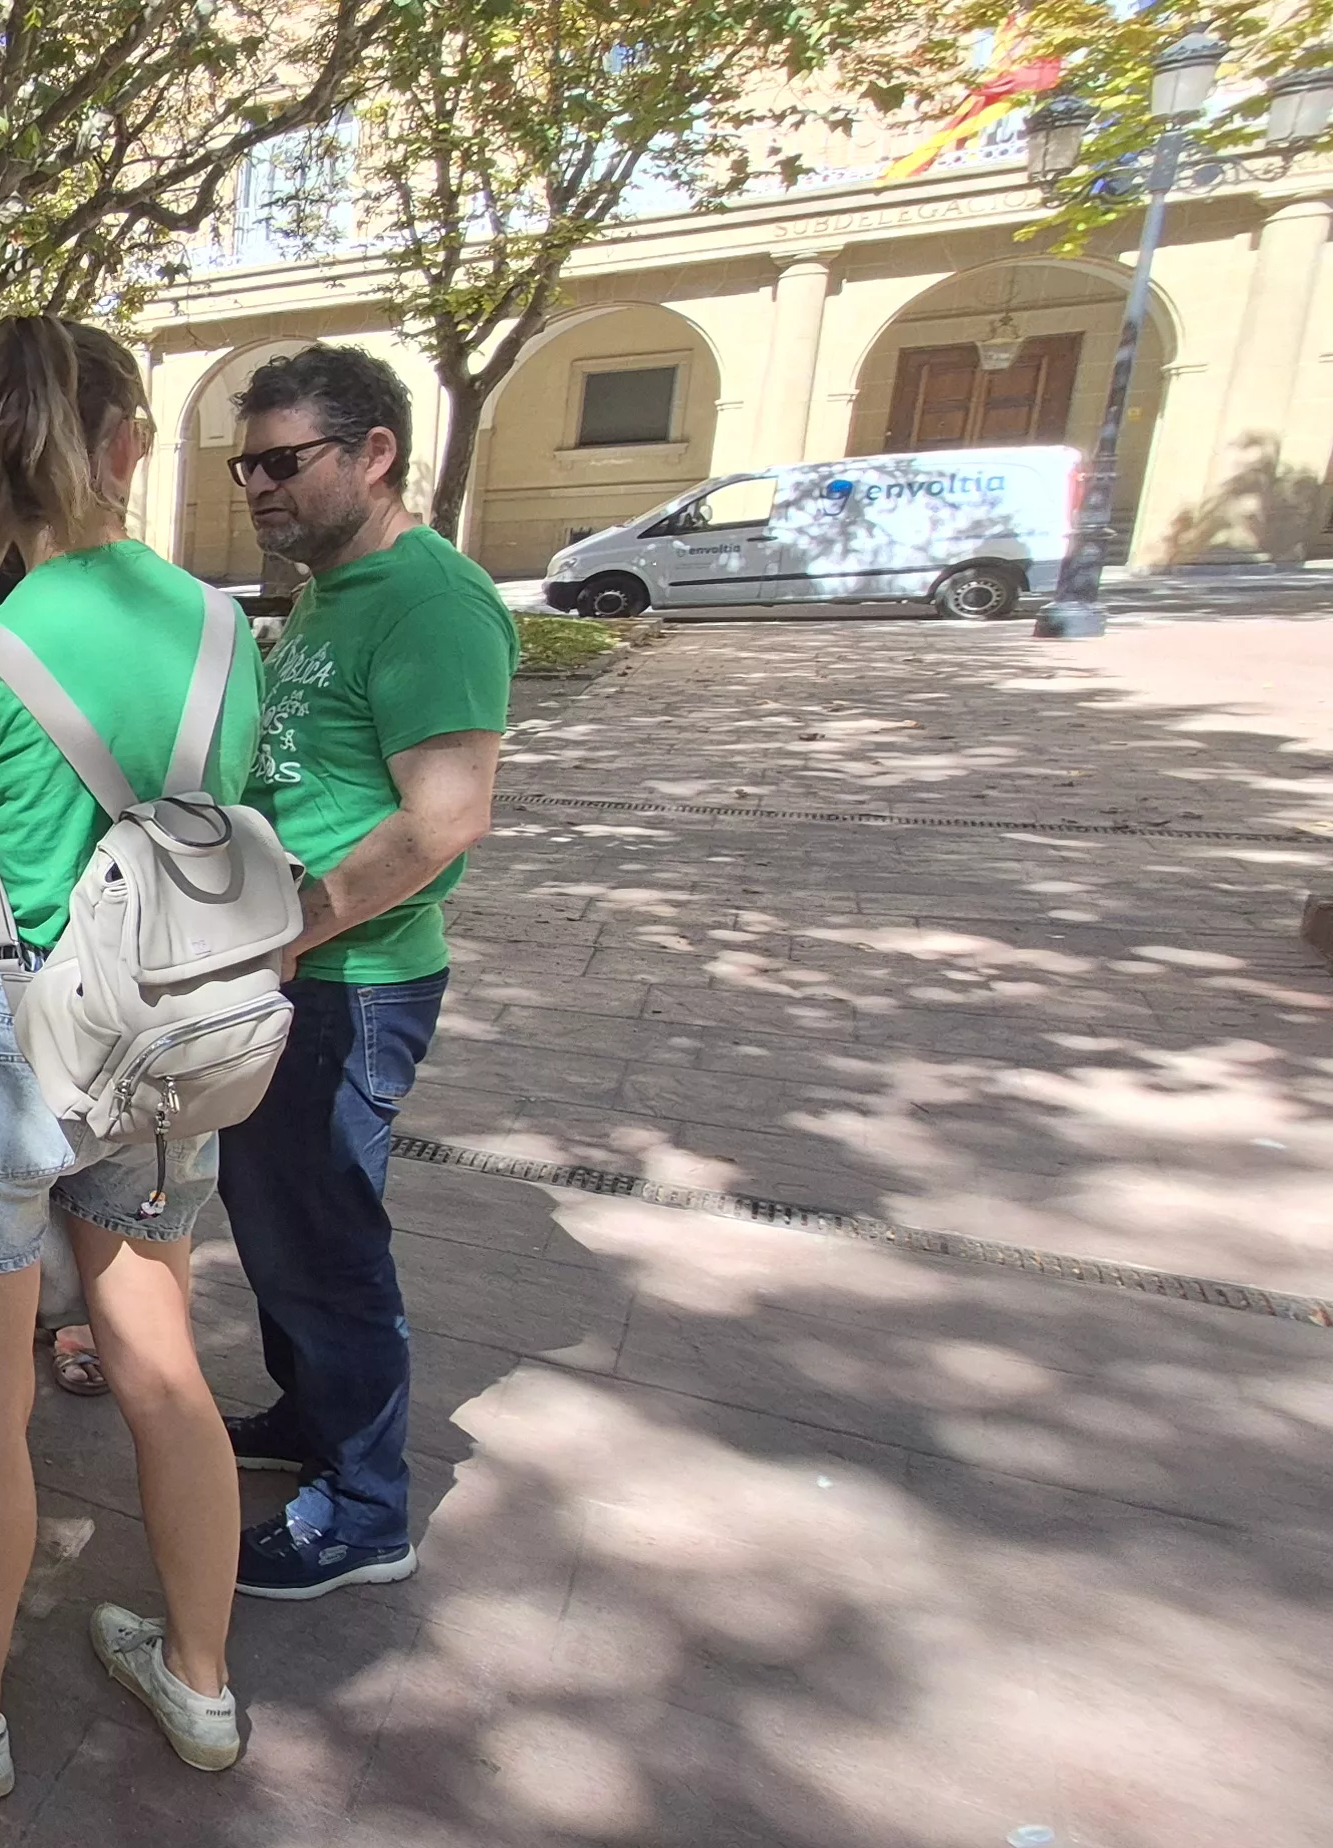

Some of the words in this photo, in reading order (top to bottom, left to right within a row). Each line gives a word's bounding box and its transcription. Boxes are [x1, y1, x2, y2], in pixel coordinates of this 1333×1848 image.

[774, 190, 1030, 238] SUBDELEGACIO
[866, 471, 1005, 501] envoltia
[689, 544, 741, 555] envoltia
